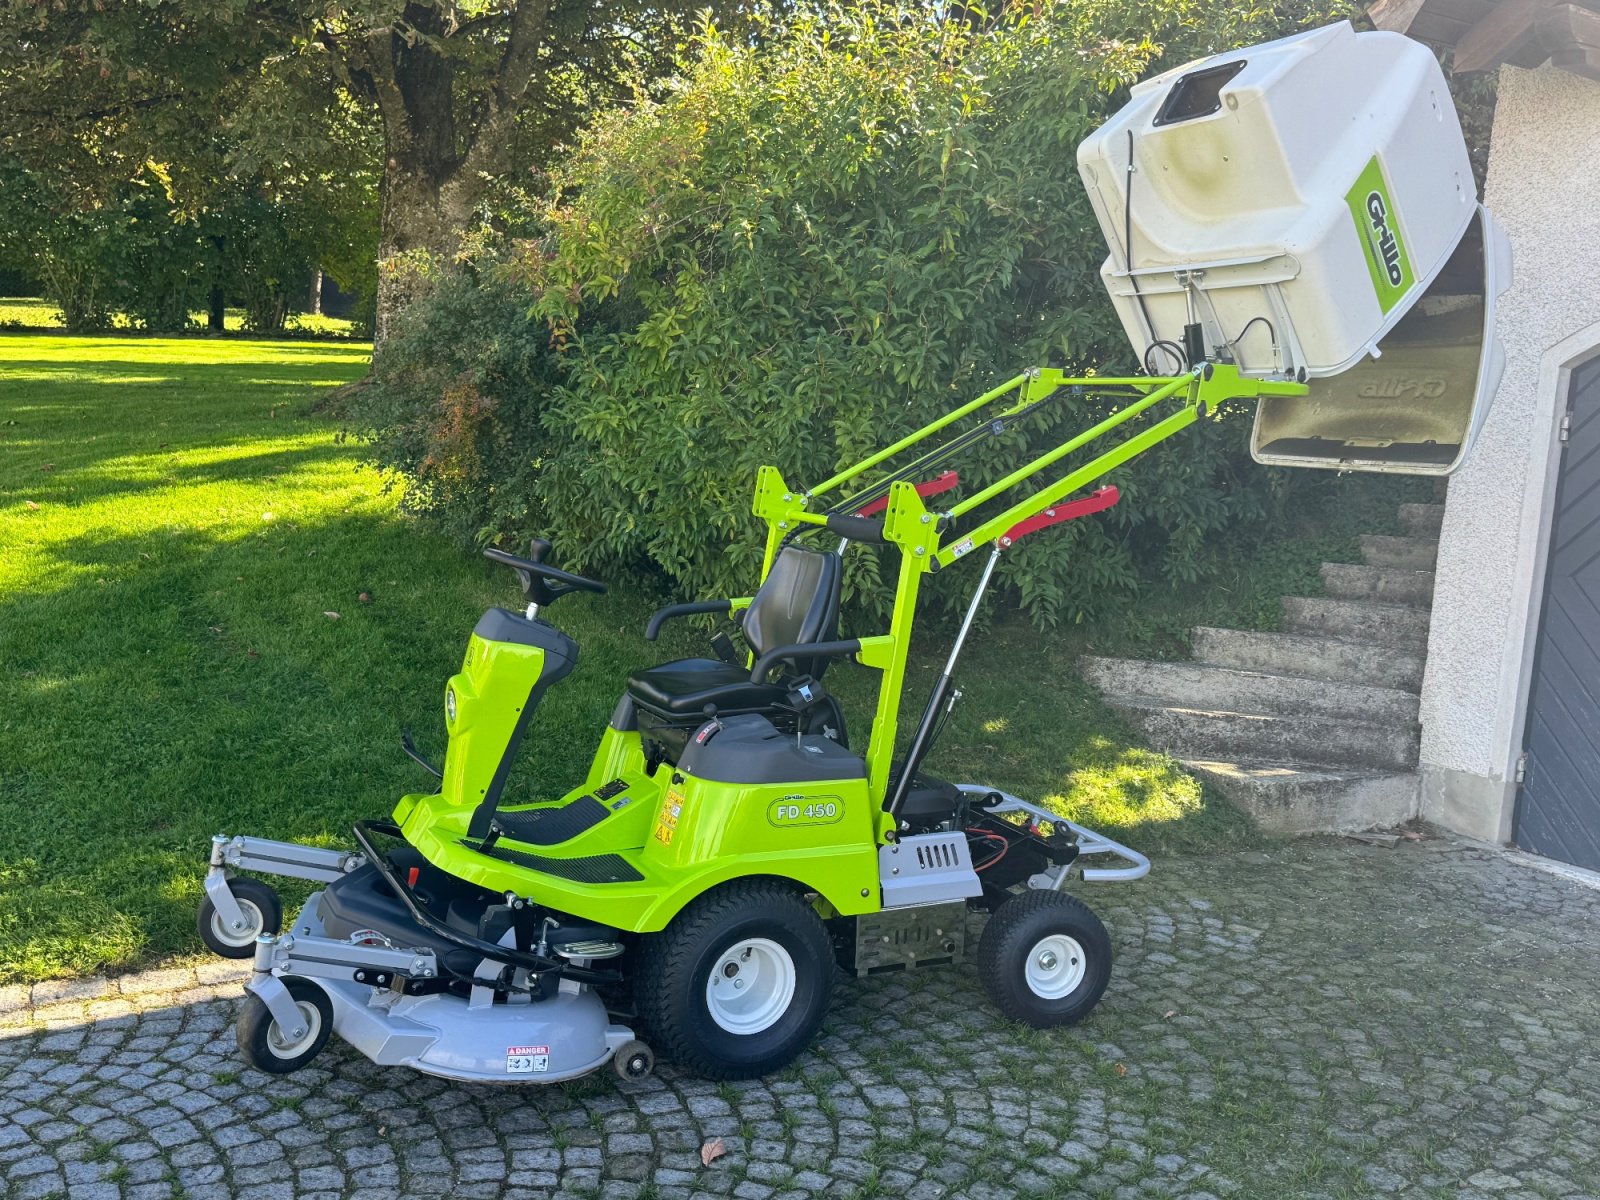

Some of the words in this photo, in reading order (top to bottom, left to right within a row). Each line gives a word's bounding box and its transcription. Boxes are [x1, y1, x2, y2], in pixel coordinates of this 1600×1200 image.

[1366, 191, 1402, 287] Grillo
[777, 805, 800, 820] FD
[803, 802, 836, 818] 450
